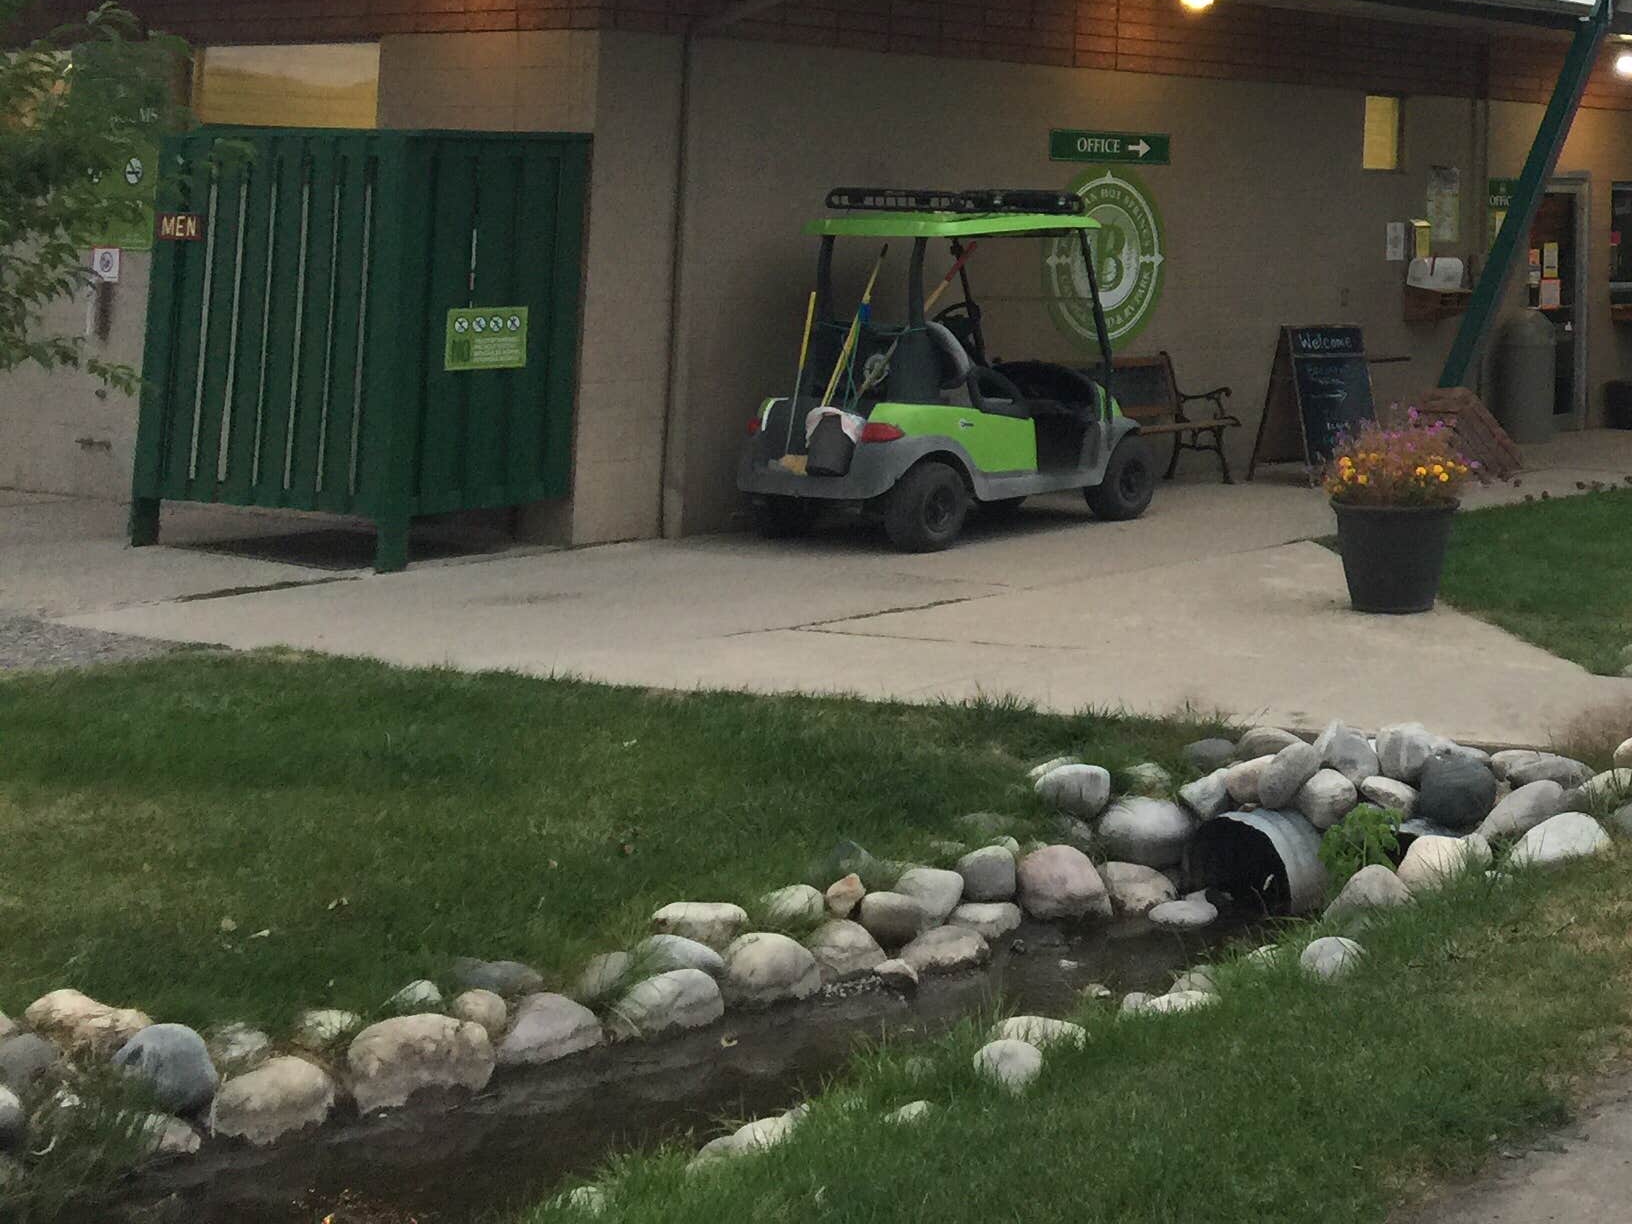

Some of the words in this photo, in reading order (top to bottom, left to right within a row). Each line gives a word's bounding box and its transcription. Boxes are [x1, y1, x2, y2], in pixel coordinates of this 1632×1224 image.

[1077, 137, 1121, 153] OFFICE
[1489, 195, 1512, 206] OFFIC
[161, 215, 197, 237] MEN
[1298, 331, 1352, 350] Welcome
